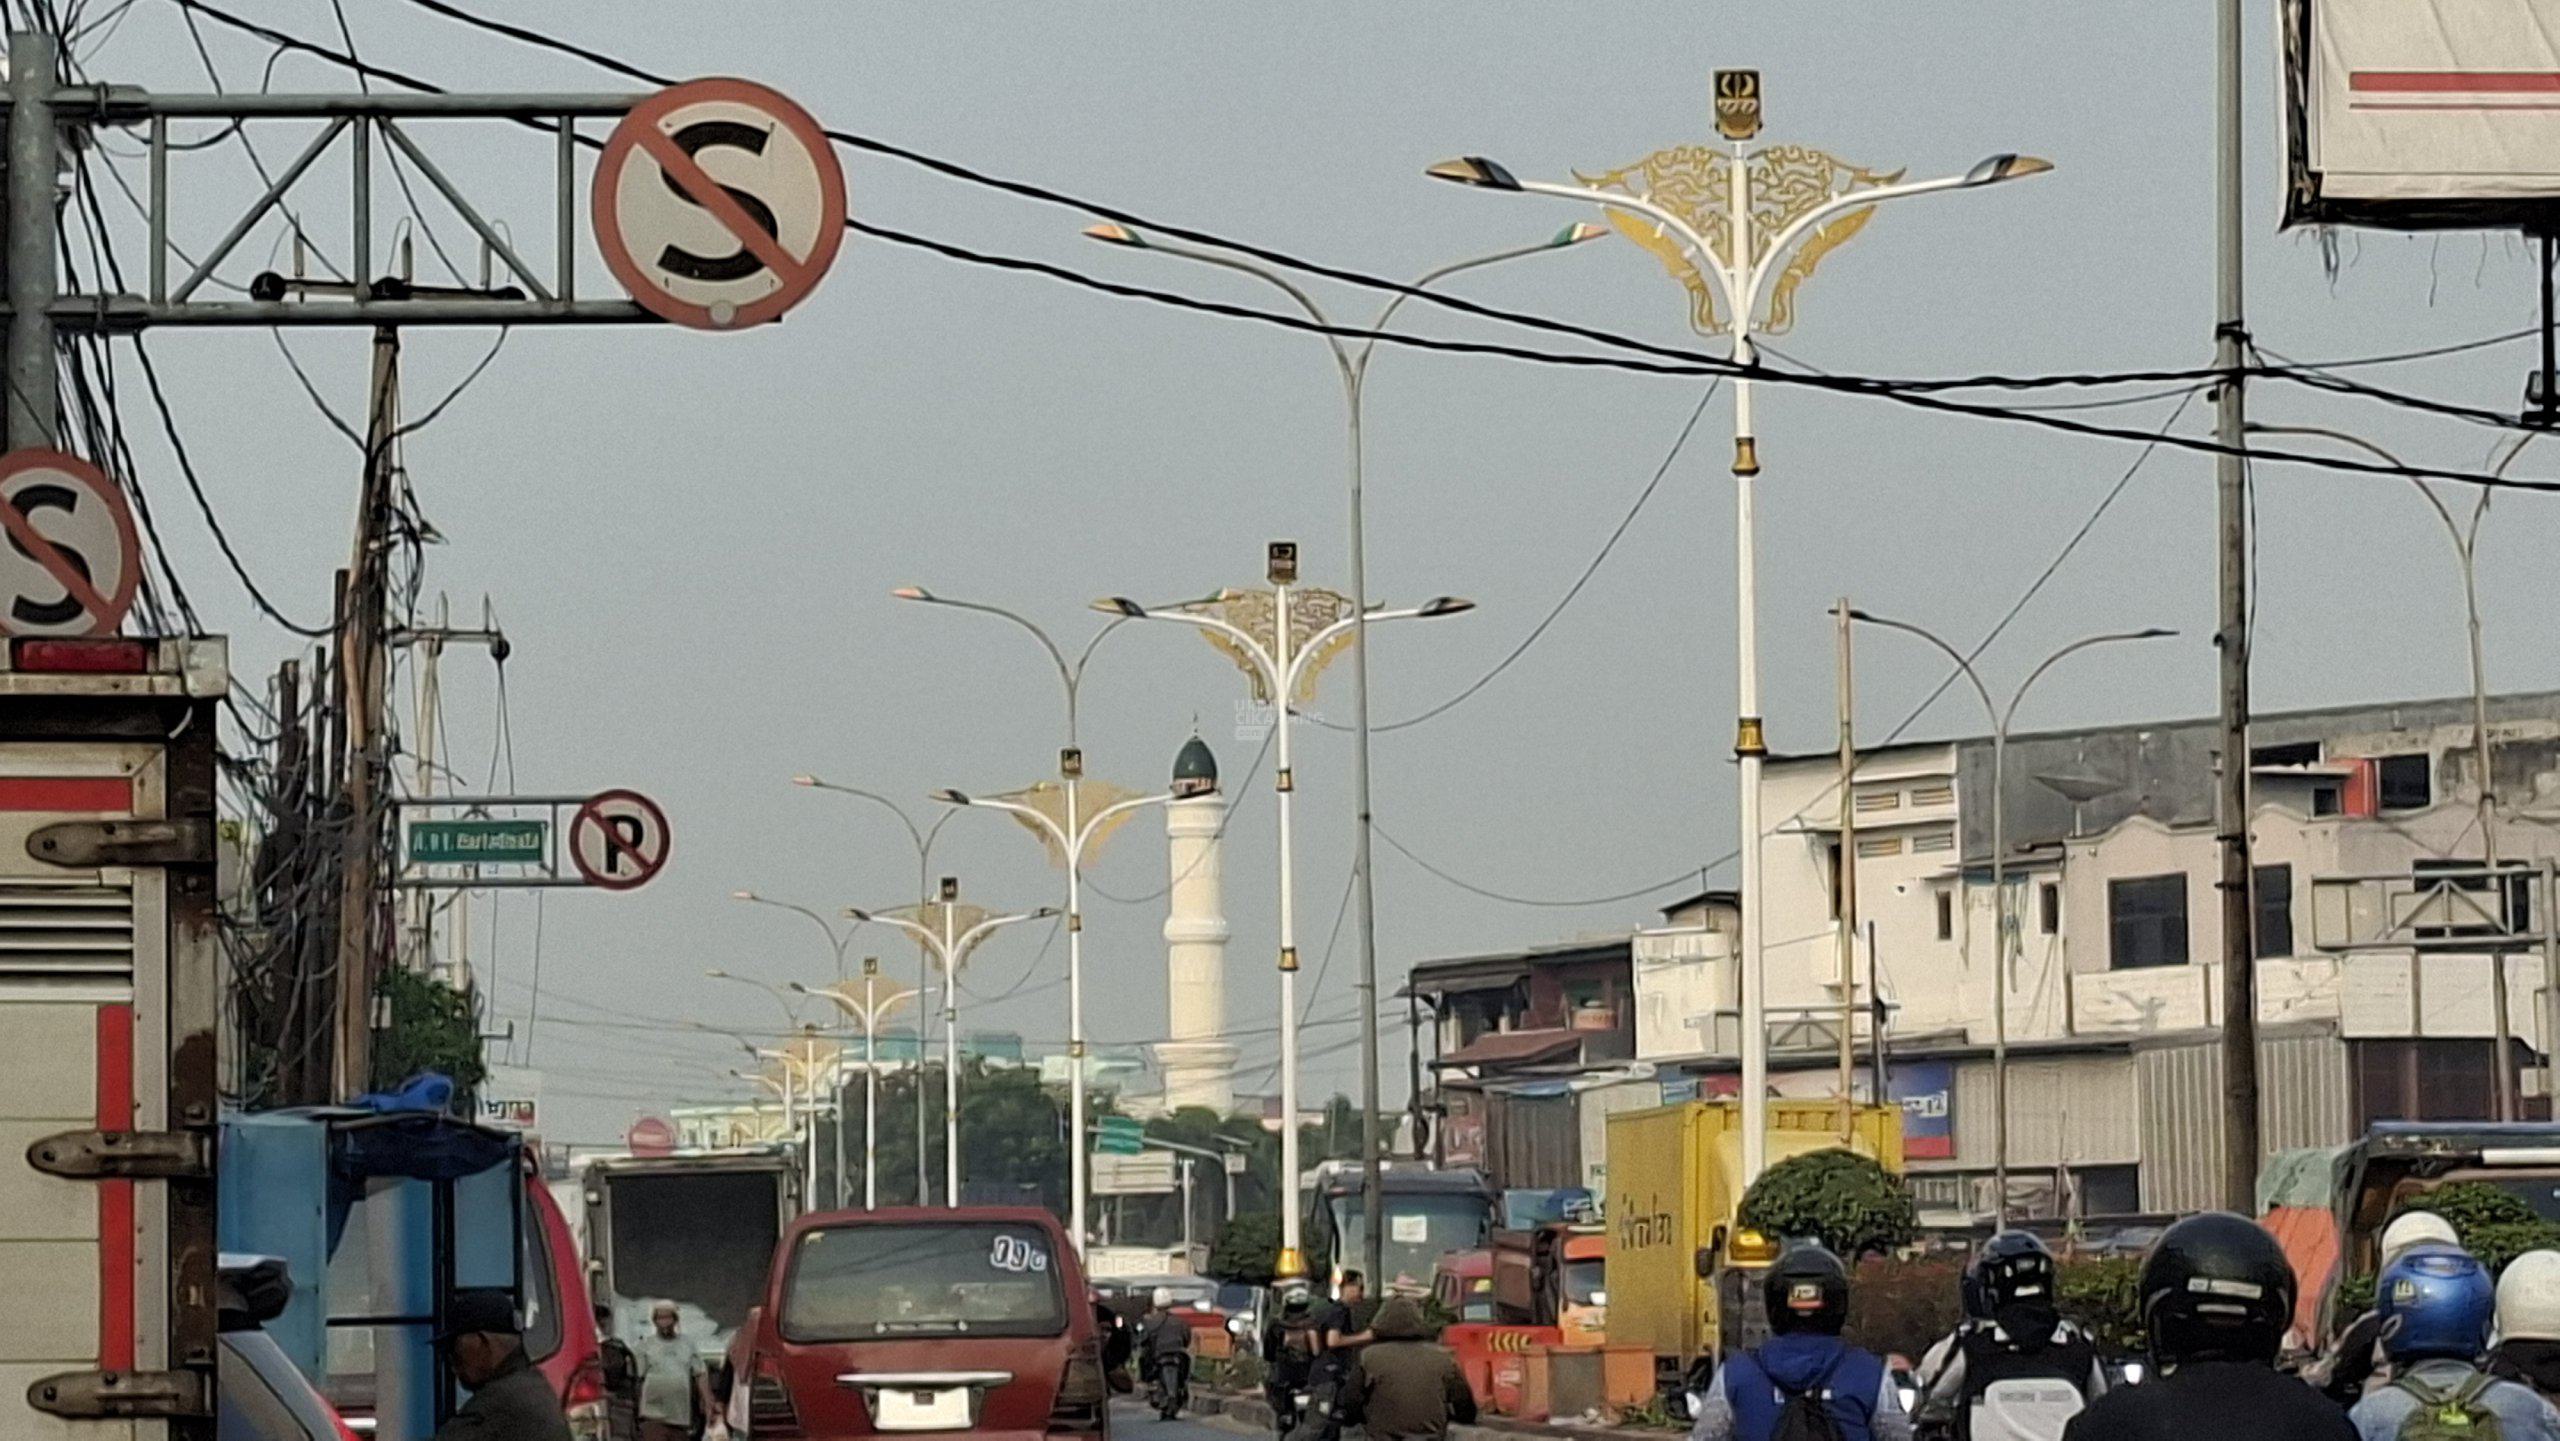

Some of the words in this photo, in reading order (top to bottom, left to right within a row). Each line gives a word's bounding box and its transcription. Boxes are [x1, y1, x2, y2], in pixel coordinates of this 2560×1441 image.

[658, 121, 778, 282] S
[6, 484, 92, 625] S
[605, 814, 644, 873] P
